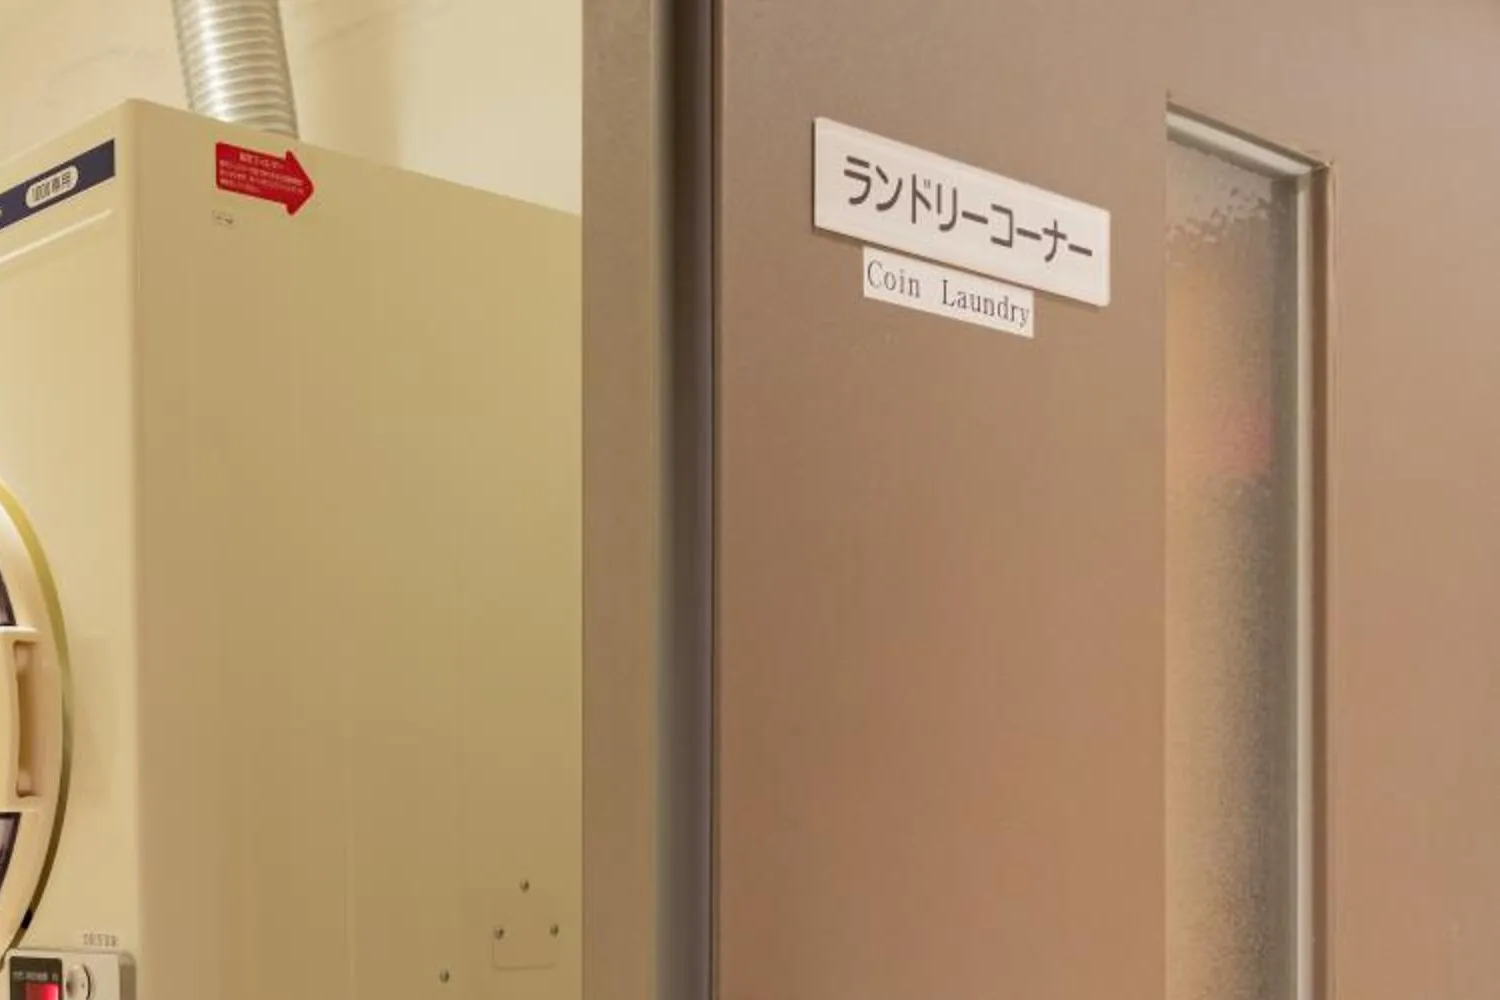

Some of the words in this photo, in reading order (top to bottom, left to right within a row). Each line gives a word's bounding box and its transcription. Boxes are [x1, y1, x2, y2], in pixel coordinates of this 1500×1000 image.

[843, 154, 1093, 263] ランドリーコーナー
[867, 260, 921, 298] Coin
[942, 278, 1031, 328] Laundry
